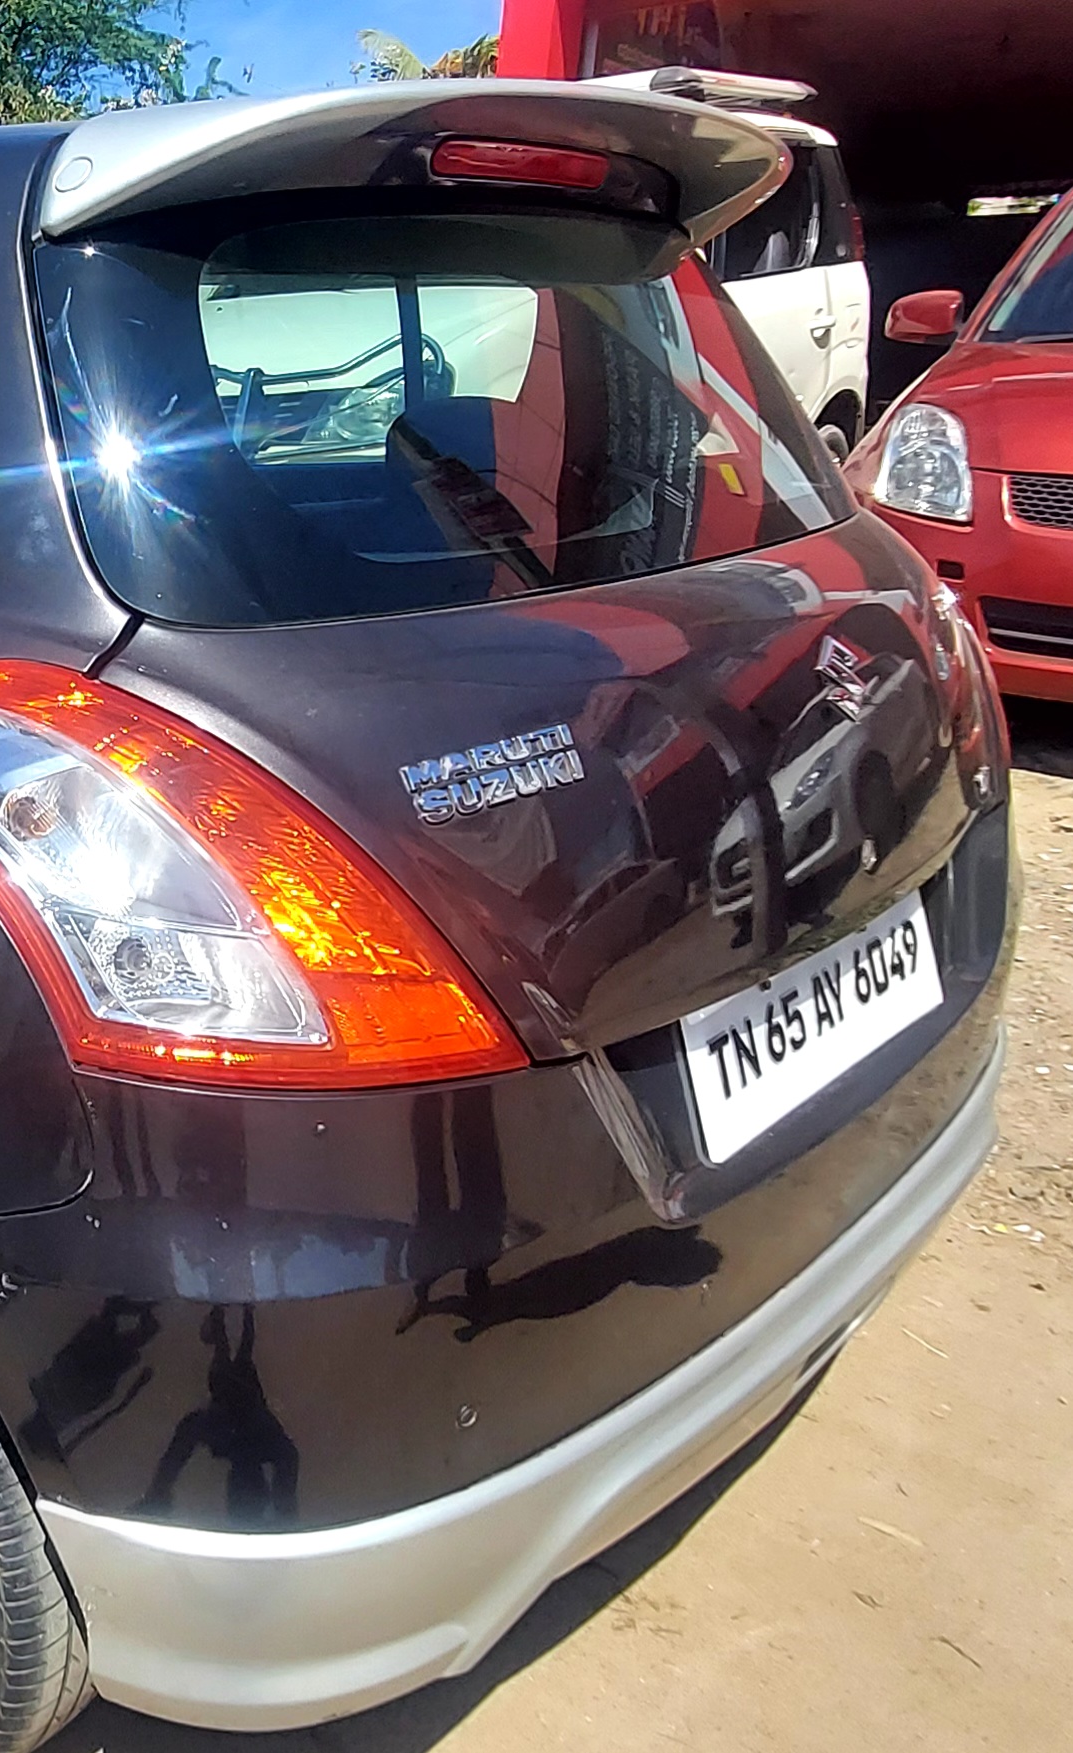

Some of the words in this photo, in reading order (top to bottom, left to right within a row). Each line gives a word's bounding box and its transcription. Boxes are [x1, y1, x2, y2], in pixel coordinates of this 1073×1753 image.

[399, 723, 575, 795] MARUTI
[413, 749, 585, 826] SUZUKI
[706, 1016, 762, 1100] TN
[765, 986, 807, 1064] 65
[811, 960, 844, 1037] AY
[853, 920, 918, 1005] 6049
